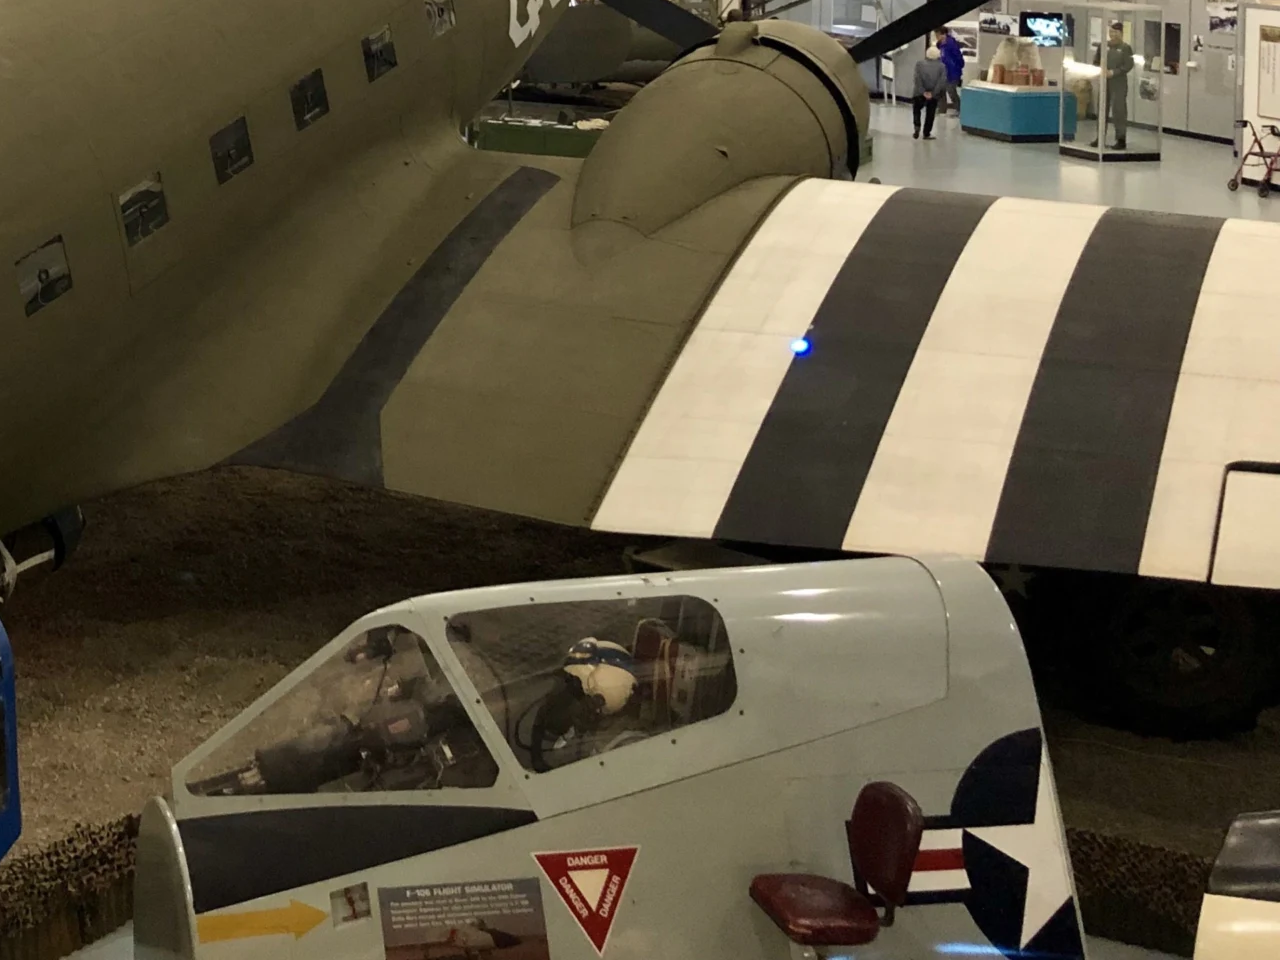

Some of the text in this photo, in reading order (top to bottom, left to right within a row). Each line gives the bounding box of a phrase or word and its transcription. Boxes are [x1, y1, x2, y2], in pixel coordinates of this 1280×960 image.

[566, 854, 608, 867] DANGER
[433, 885, 462, 896] FLIGHT
[464, 882, 514, 894] SIMULATOR
[559, 876, 589, 919] DANGER
[599, 874, 621, 918] DANGER
